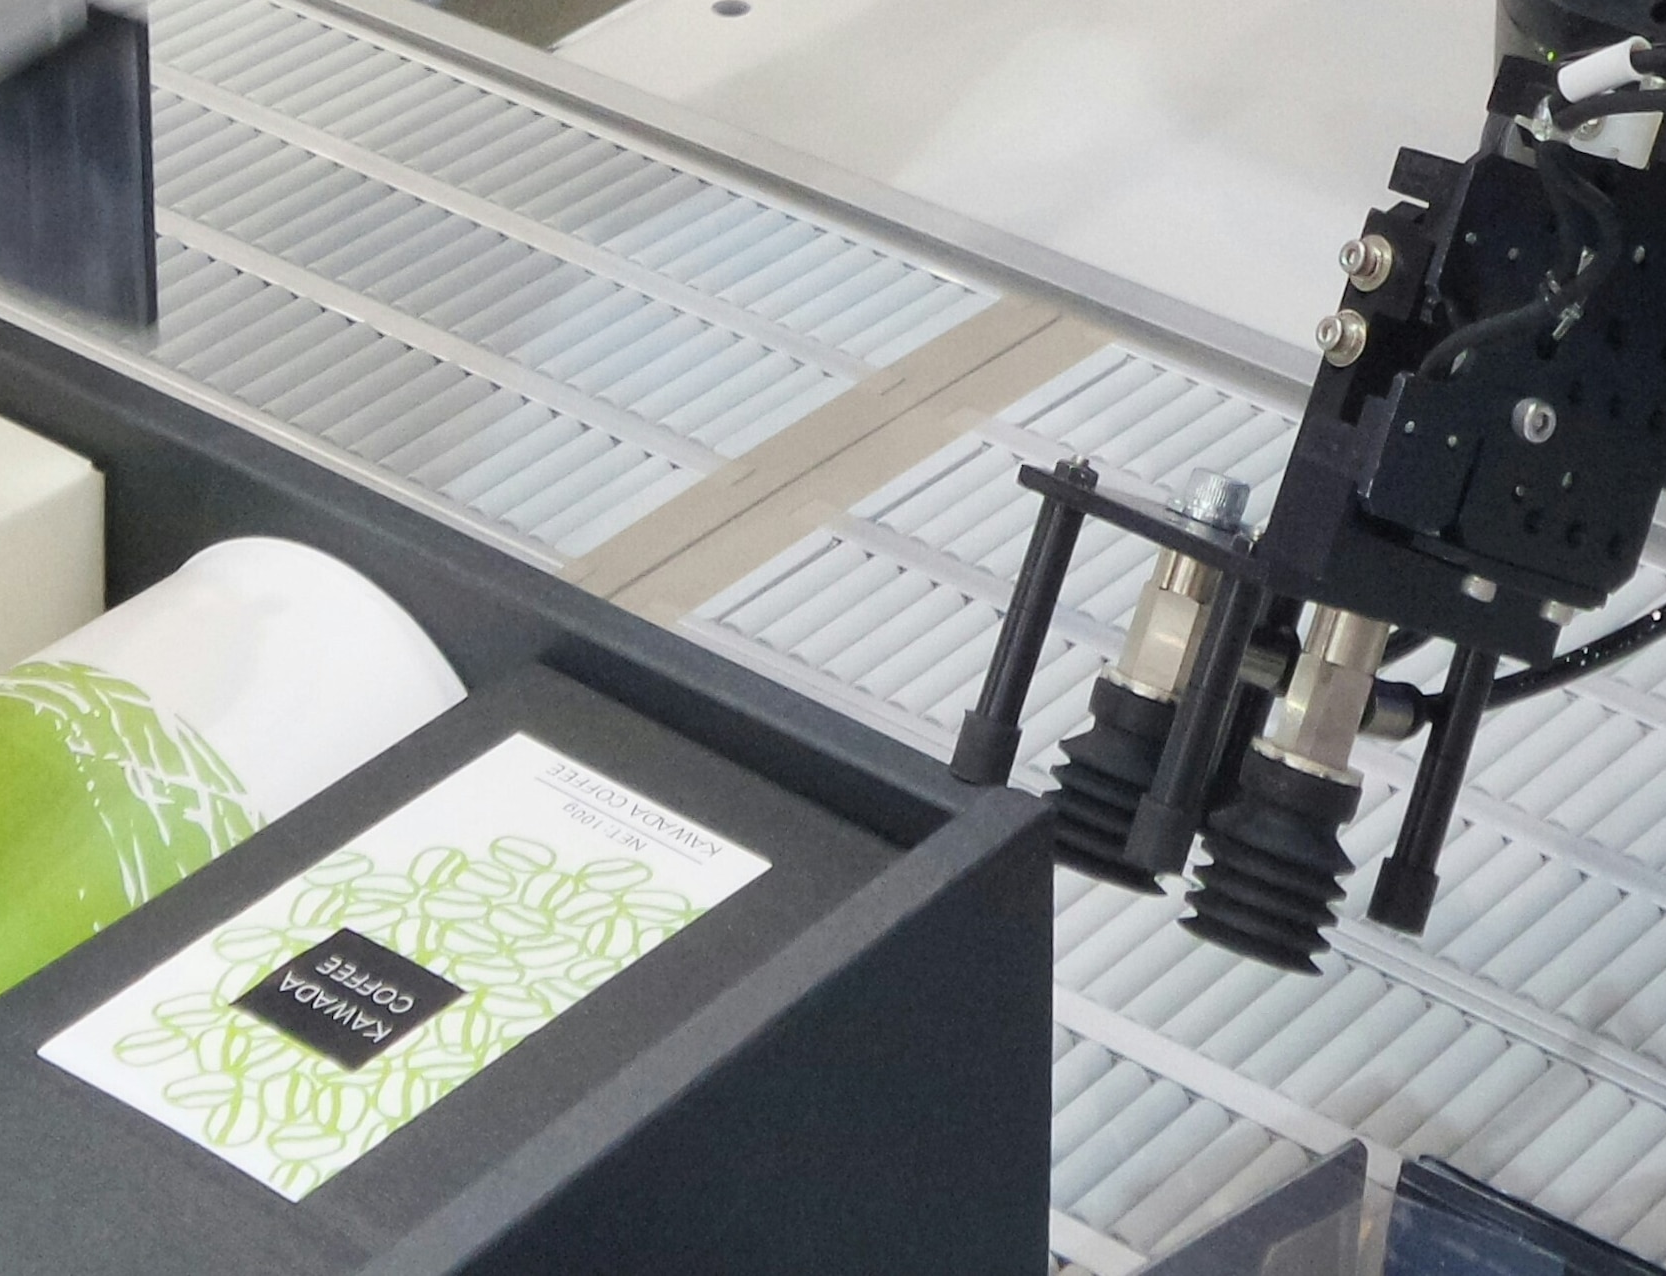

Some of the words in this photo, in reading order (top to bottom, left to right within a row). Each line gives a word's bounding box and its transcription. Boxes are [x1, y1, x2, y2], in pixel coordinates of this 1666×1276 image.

[545, 762, 629, 809] COFFEE
[630, 803, 723, 858] KAWADA
[279, 970, 393, 1044] KAWADA
[315, 955, 415, 1015] COFFEE
